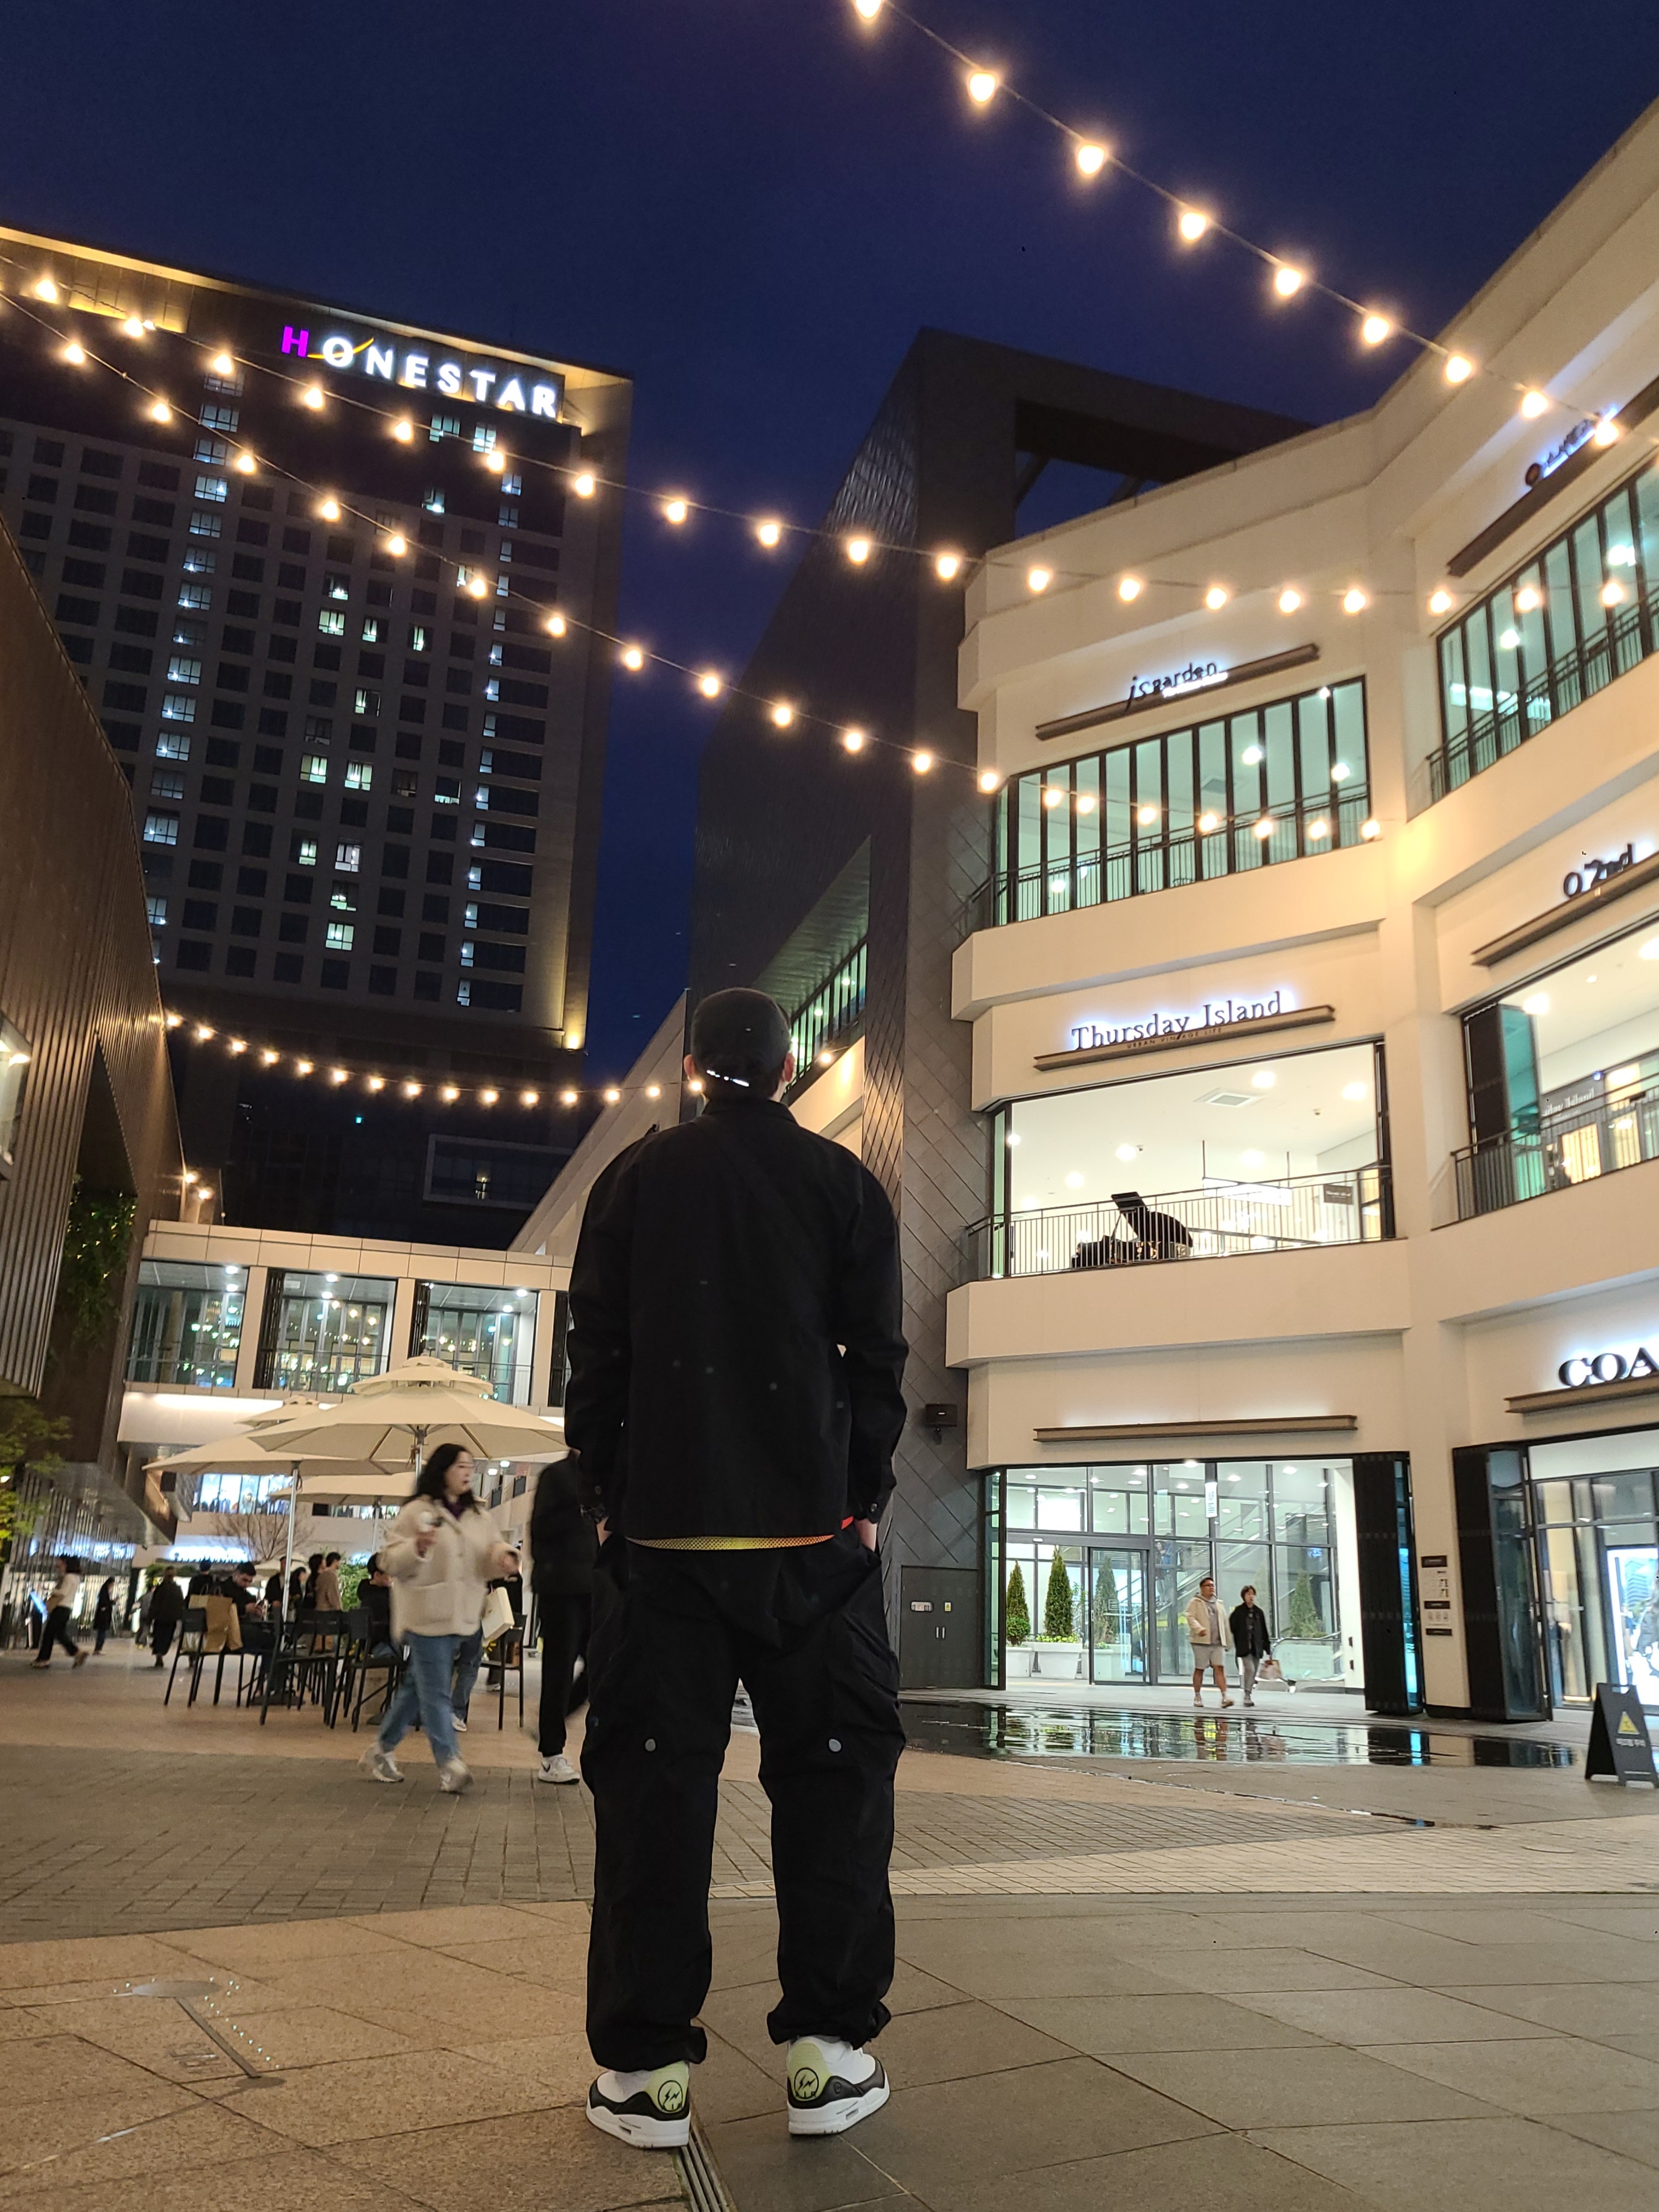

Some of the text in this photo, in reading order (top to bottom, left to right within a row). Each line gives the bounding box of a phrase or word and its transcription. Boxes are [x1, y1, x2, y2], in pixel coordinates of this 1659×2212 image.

[281, 325, 556, 418] HONESTAR
[1071, 990, 1281, 1051] Thursday Island
[1127, 1039, 1155, 1049] URBAN
[1161, 1032, 1199, 1042] VINAGE
